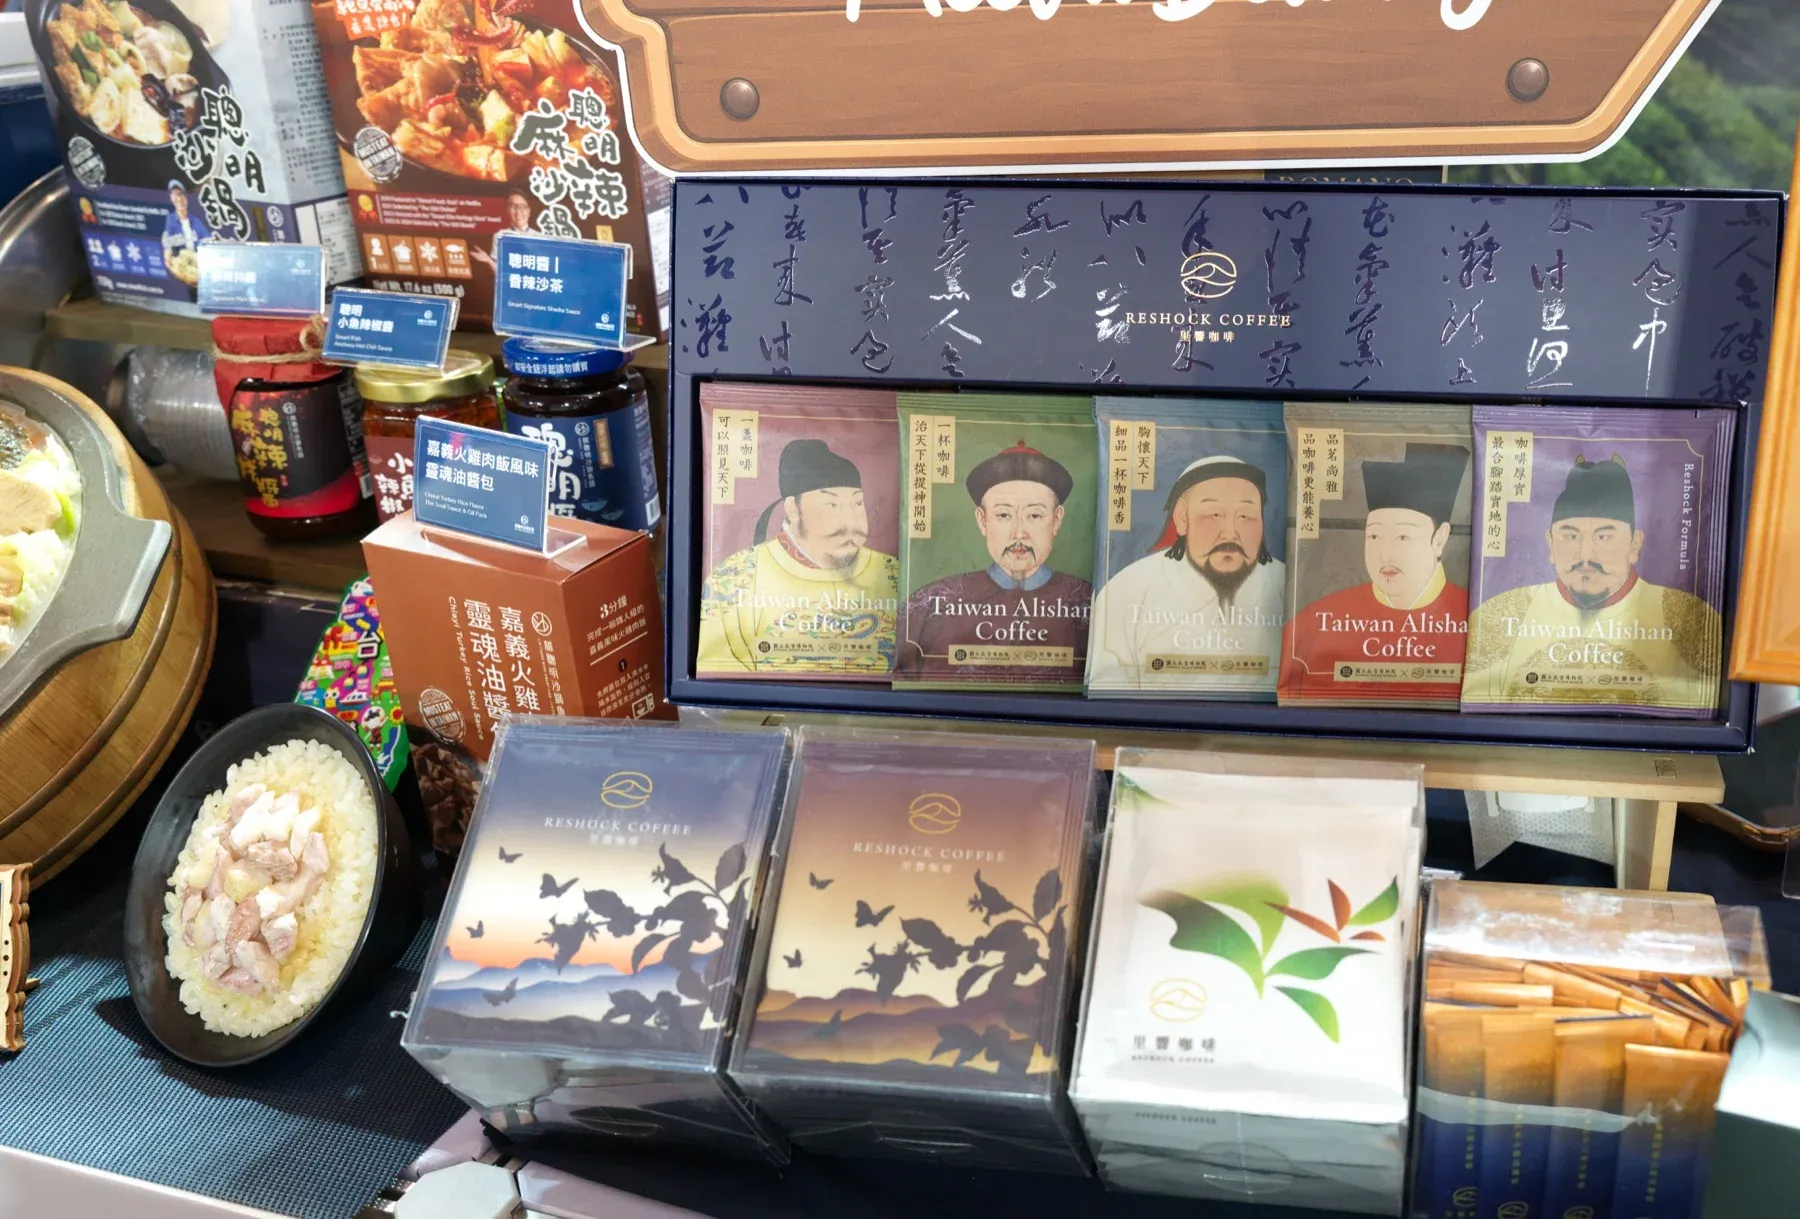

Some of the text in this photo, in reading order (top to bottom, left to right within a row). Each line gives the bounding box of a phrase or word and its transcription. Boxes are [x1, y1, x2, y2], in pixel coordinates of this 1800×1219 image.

[566, 87, 620, 164] 聰明
[201, 85, 266, 193] 聰明
[508, 253, 550, 272] 聰明醬
[509, 273, 563, 294] 香辣沙茶
[1125, 312, 1291, 327] RESHOCK COFFEE
[739, 416, 754, 472] 一盞咖啡
[936, 422, 951, 478] 一杯咖啡
[1137, 426, 1151, 484] 胸懷天下
[427, 440, 539, 479] 嘉義火雞肉飯風味
[717, 415, 731, 499] 可以照見天下
[1326, 433, 1339, 494] 品茗尚雅
[1514, 437, 1529, 497] 咖啡厚實
[426, 462, 494, 491] 靈魂油醬包
[913, 420, 927, 532] 治天下從提神開始
[1113, 425, 1128, 524] 細品一杯咖啡香
[1301, 433, 1316, 532] 品咖啡更能養心
[435, 501, 446, 510] Soul
[447, 504, 461, 513] Sauce
[475, 510, 487, 519] Pack
[440, 494, 457, 504] Turkey
[458, 498, 468, 506] Rice
[469, 501, 485, 510] Flavor
[1680, 462, 1694, 571] Reshock Formula
[600, 595, 628, 619] 3分鐘
[736, 588, 897, 610] Taiwan Alishan
[928, 595, 1007, 617] Taiwan
[779, 613, 853, 633] Coffee
[1128, 604, 1204, 625] Taiwan
[1315, 612, 1394, 632] Taiwan
[975, 620, 1048, 641] Coffee
[1173, 628, 1245, 650] Coffee
[1501, 617, 1673, 641] Taiwan Alishan
[1362, 637, 1436, 657] Coffee
[1549, 642, 1624, 665] Coffee
[448, 596, 484, 740] Chiayi Turkey Rice Soul Sauce
[498, 606, 541, 716] 嘉義火雞
[544, 817, 692, 835] RESHOCK COFFEE
[853, 841, 1005, 862] RESHOCK COFFEE
